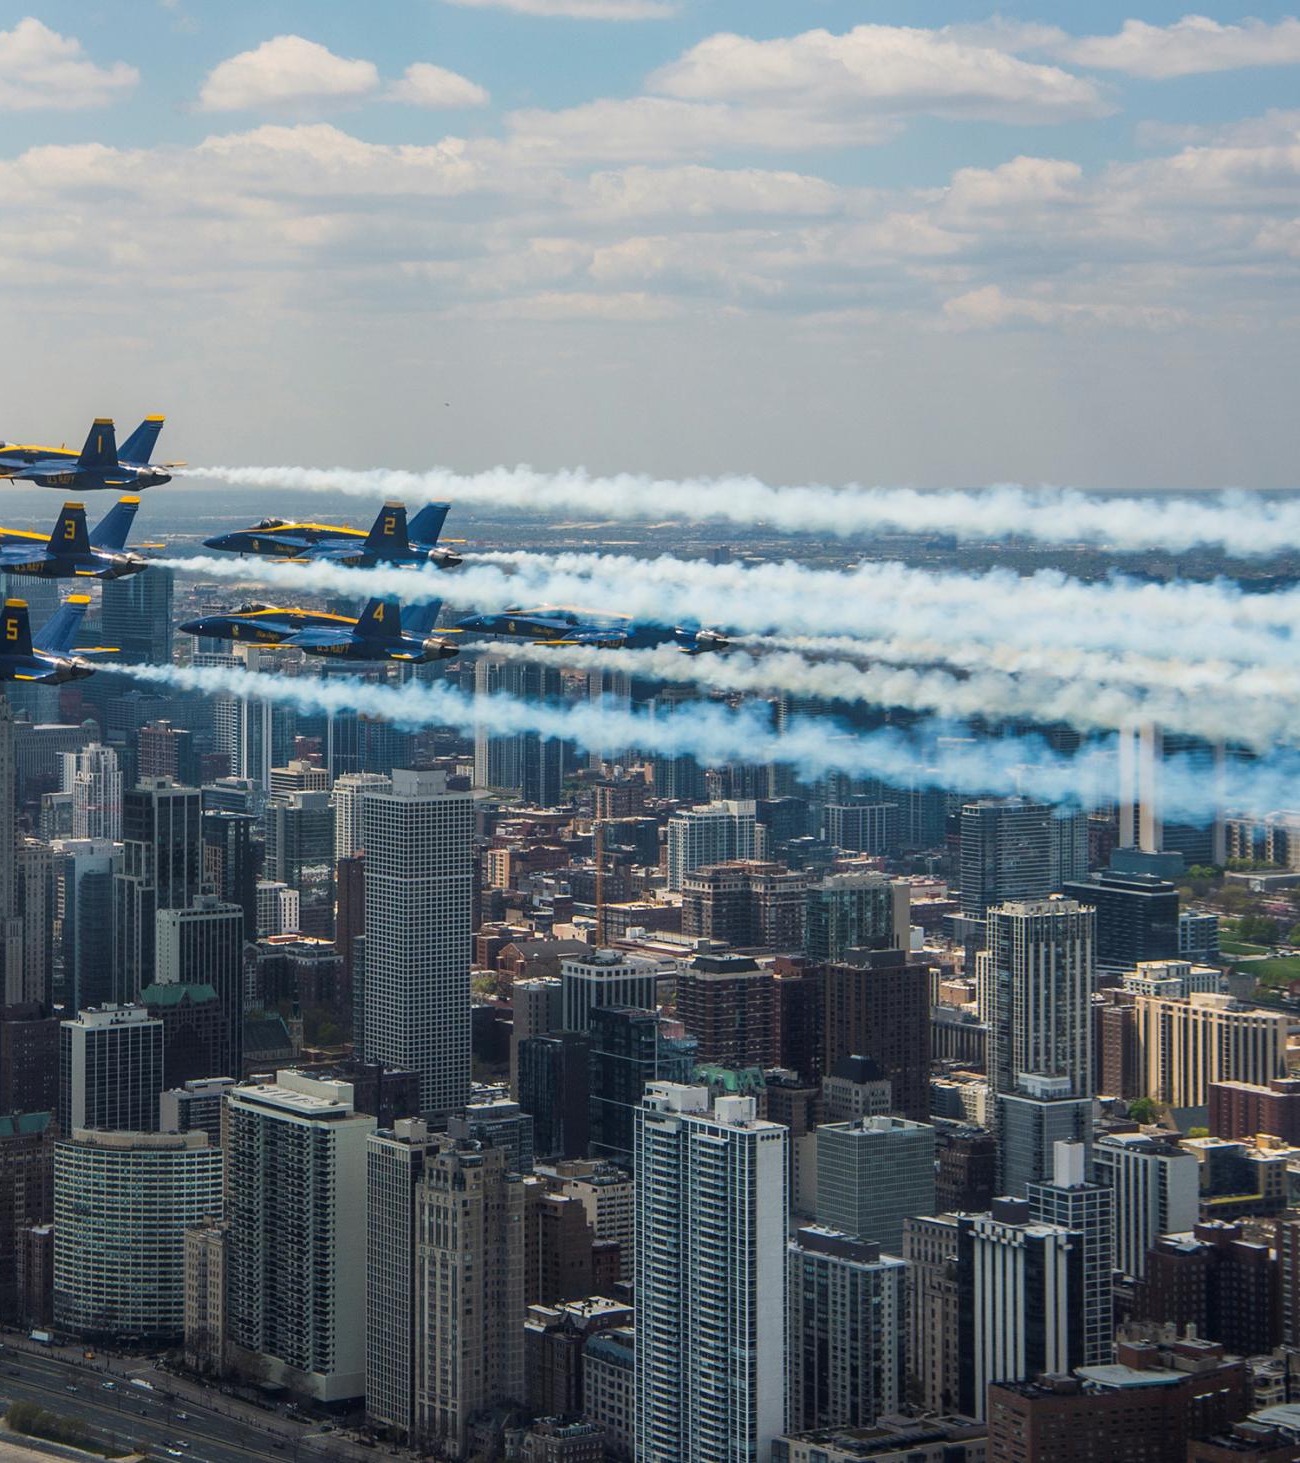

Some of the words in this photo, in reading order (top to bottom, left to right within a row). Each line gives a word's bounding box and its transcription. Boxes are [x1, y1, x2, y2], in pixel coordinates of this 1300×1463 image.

[97, 434, 102, 454] 1
[64, 520, 76, 539] 3
[384, 517, 396, 535] 2
[373, 602, 384, 622] 4
[6, 618, 18, 640] 5
